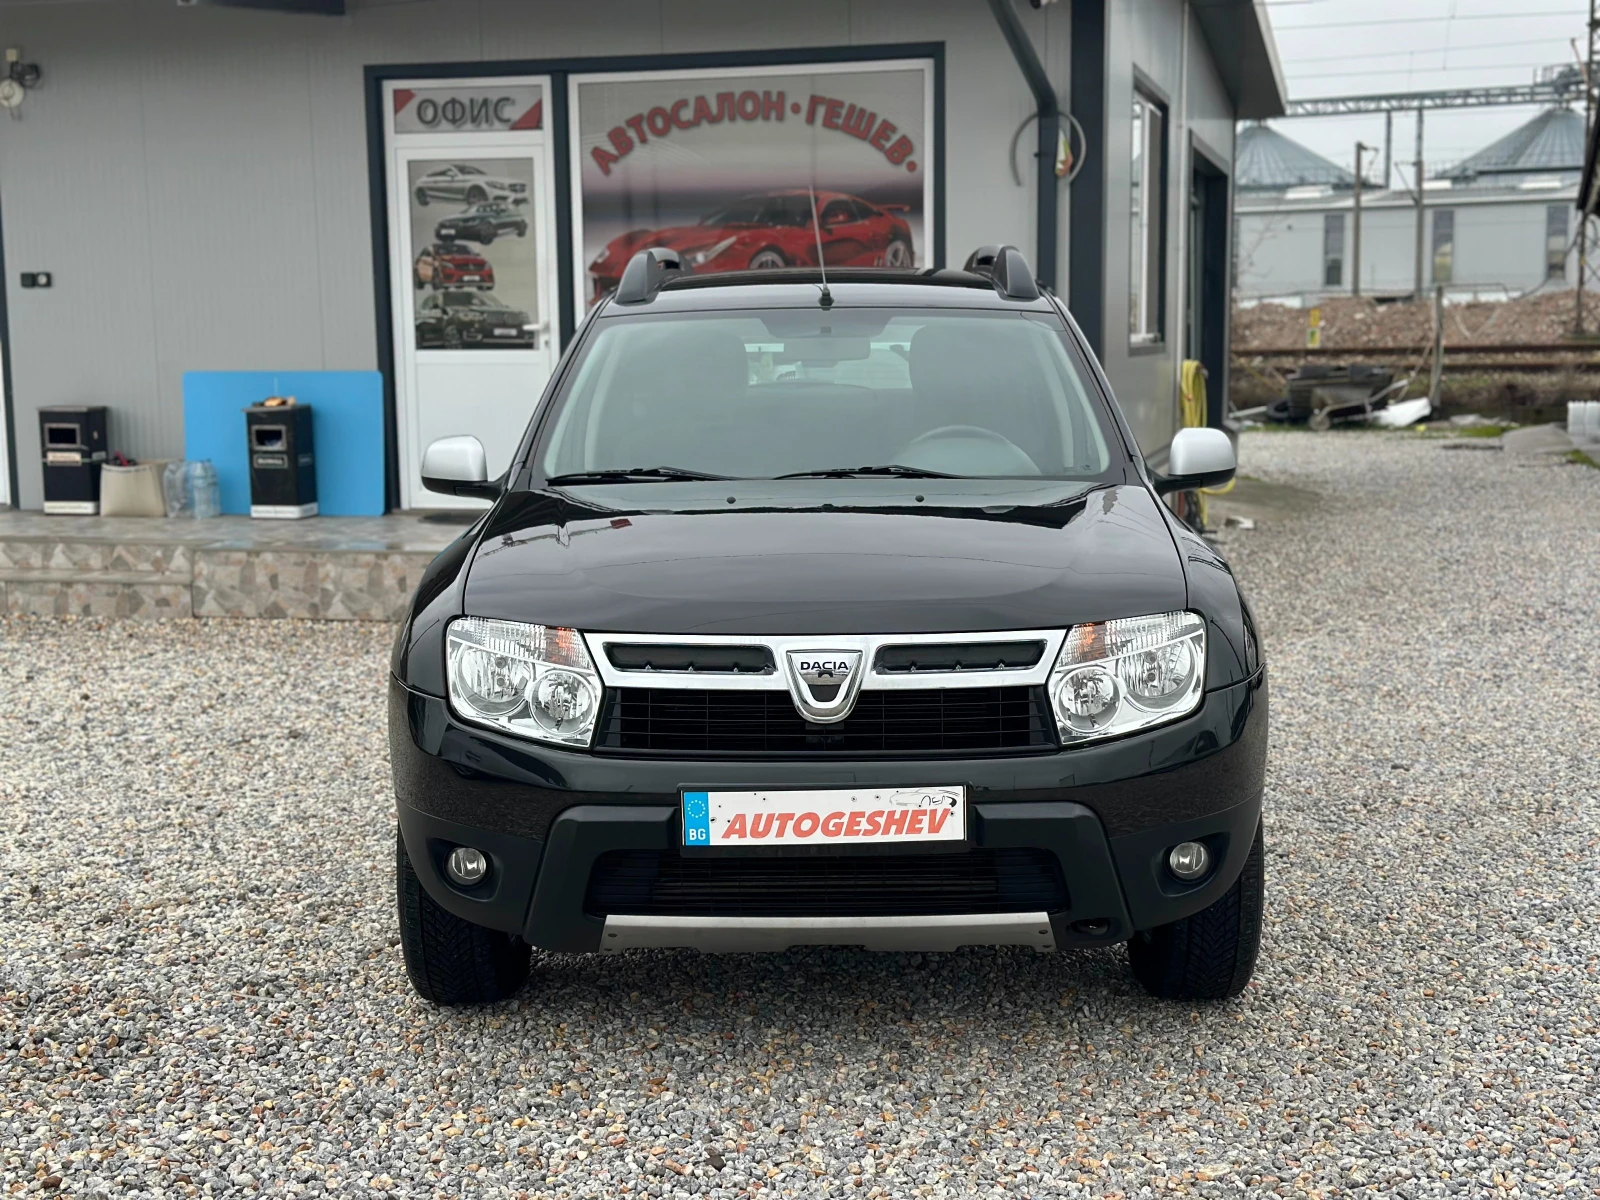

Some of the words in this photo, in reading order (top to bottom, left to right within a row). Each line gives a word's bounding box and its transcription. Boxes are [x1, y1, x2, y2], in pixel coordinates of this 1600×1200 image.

[416, 96, 514, 127] ОФИС
[590, 91, 785, 175] АВТОСАЛОН
[805, 94, 917, 166] ГЕШЕВ
[800, 661, 849, 671] DACIA
[688, 828, 707, 841] BG
[721, 808, 951, 839] AUTOGESHEV
